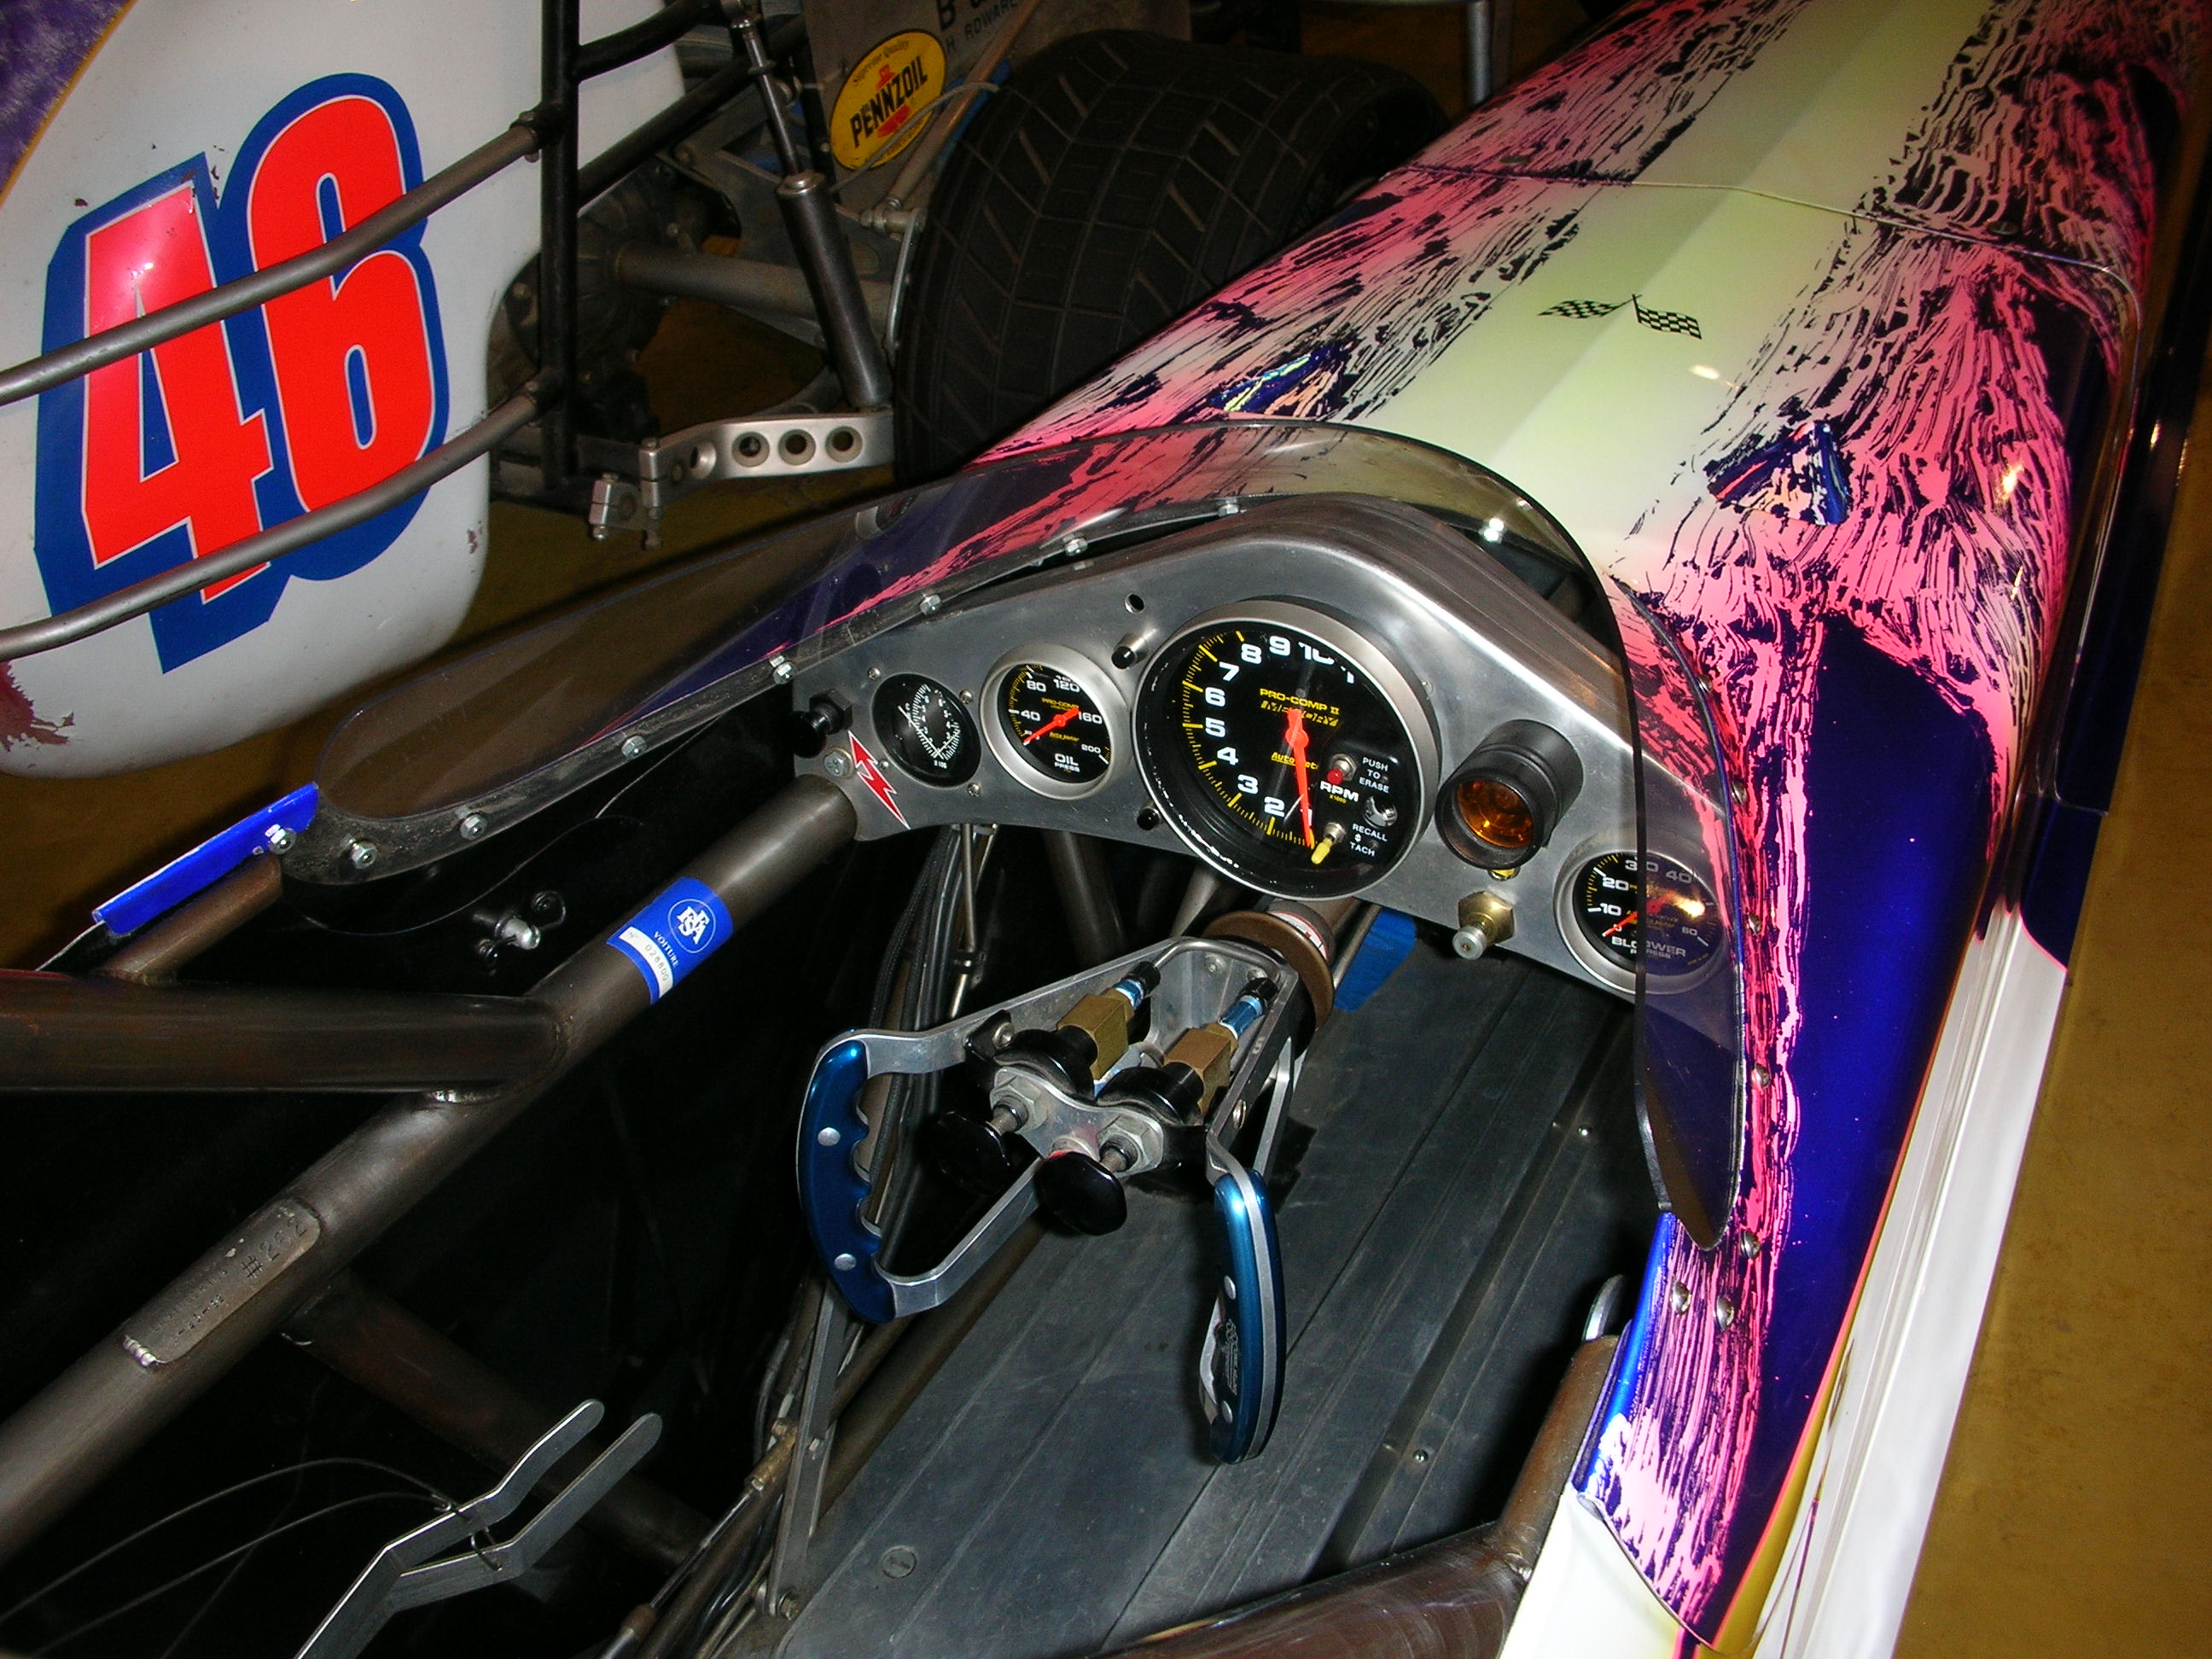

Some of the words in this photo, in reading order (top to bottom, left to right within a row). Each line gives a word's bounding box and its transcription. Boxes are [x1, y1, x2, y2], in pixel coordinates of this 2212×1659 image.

[850, 55, 928, 148] PENNZOIL
[81, 94, 437, 604] 46
[1241, 643, 1262, 664] 8
[1269, 635, 1290, 656] 9
[1219, 662, 1239, 681] 7
[1026, 679, 1046, 692] 80
[1053, 678, 1080, 692] 120
[1205, 687, 1225, 707] 6
[1260, 688, 1328, 711] PRO-COMP
[1330, 706, 1341, 715] II
[1021, 709, 1041, 721] 40
[1078, 711, 1103, 725] 160
[1205, 718, 1225, 737] 5
[1081, 744, 1101, 754] 200
[1217, 747, 1238, 765] 4
[1054, 753, 1079, 765] OIL
[1362, 757, 1388, 771] PUSH
[1054, 763, 1080, 772] PRESS
[1366, 769, 1381, 780] TO
[1237, 775, 1259, 795] 3
[1319, 781, 1359, 802] RPM
[1359, 777, 1390, 793] ERASE
[1264, 796, 1285, 817] 2
[1352, 824, 1388, 841] RECALL
[1349, 841, 1376, 857] TACH
[1602, 878, 1629, 891] 20
[1665, 870, 1692, 884] 40
[1599, 903, 1622, 917] 10
[653, 931, 681, 969] VOITURE
